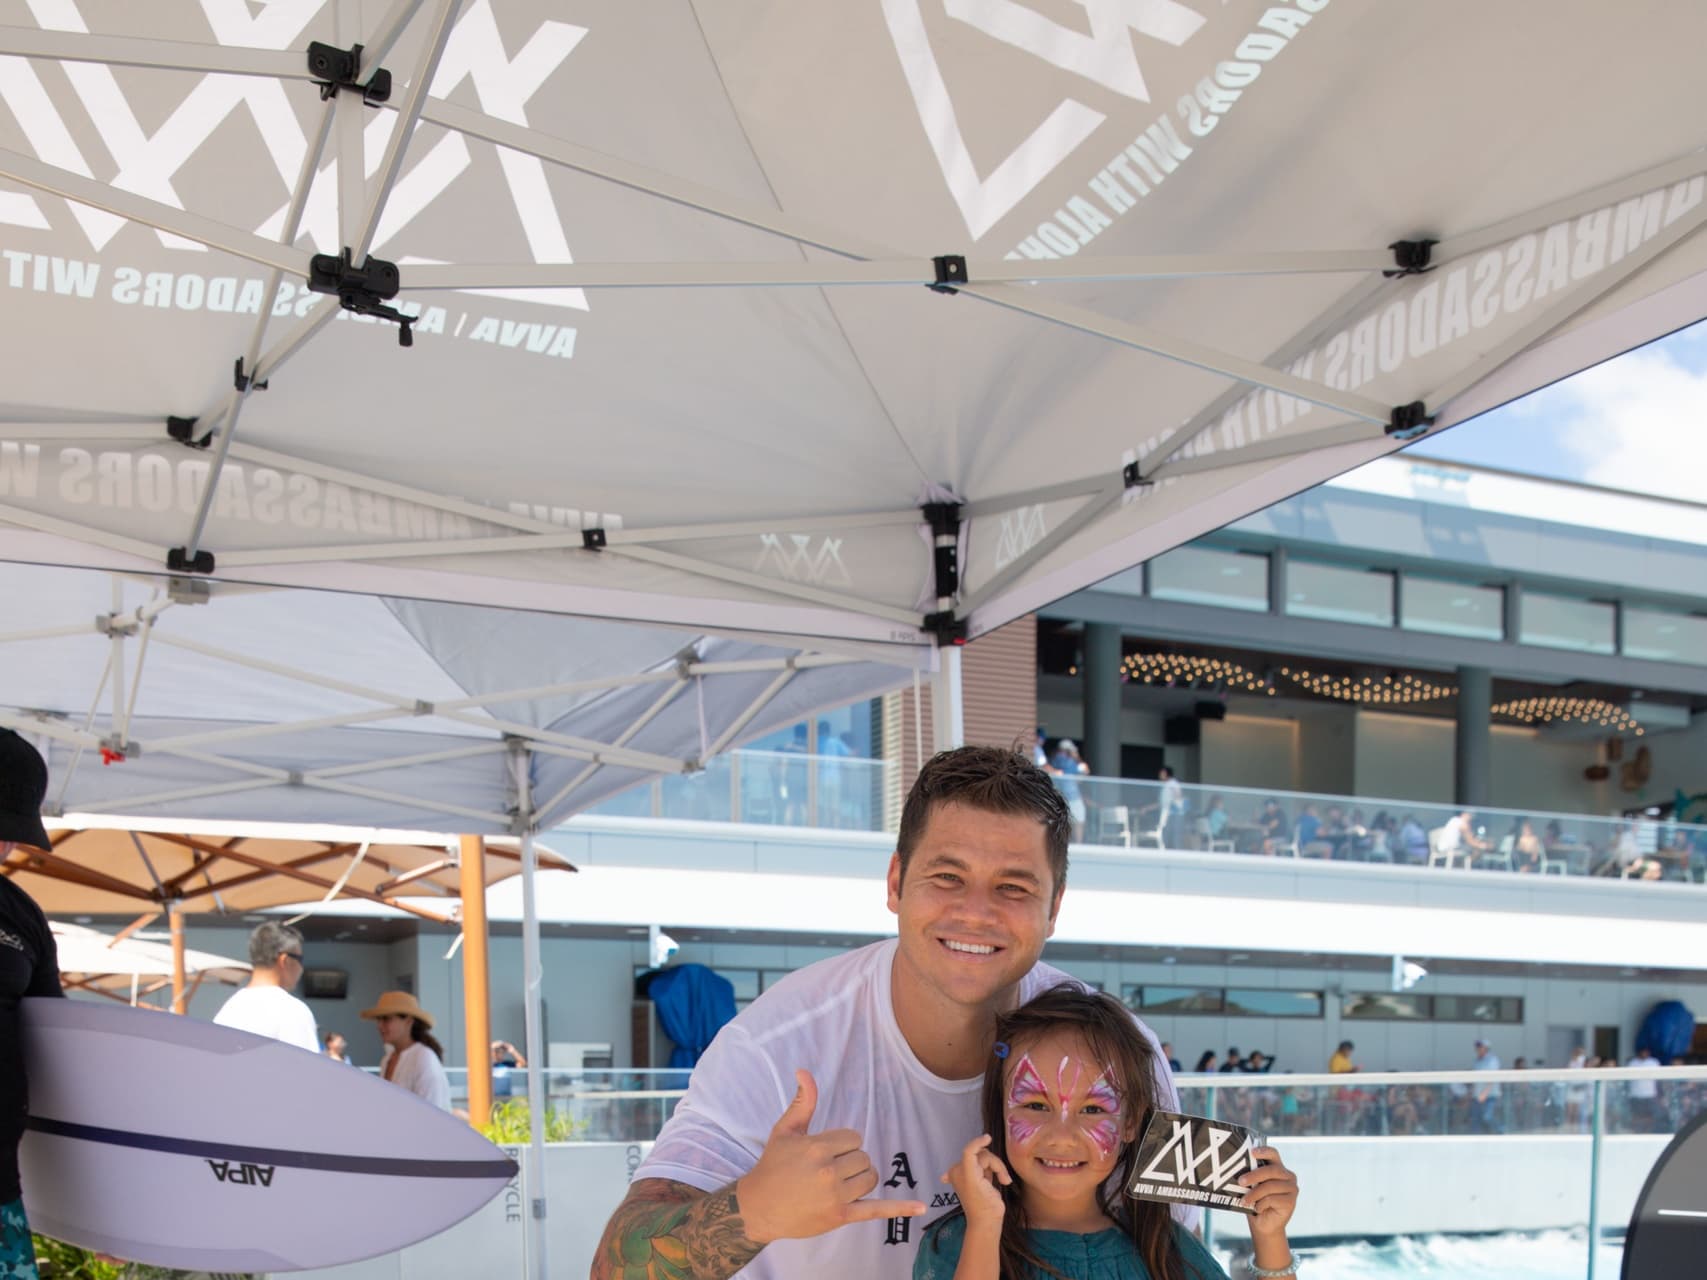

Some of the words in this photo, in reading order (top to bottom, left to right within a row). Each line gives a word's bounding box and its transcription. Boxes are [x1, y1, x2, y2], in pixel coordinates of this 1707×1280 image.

[205, 1159, 275, 1187] AIPA
[505, 1147, 520, 1222] RYCLE
[1156, 1185, 1210, 1202] AMBASSADORS
[1209, 1192, 1232, 1206] WITH
